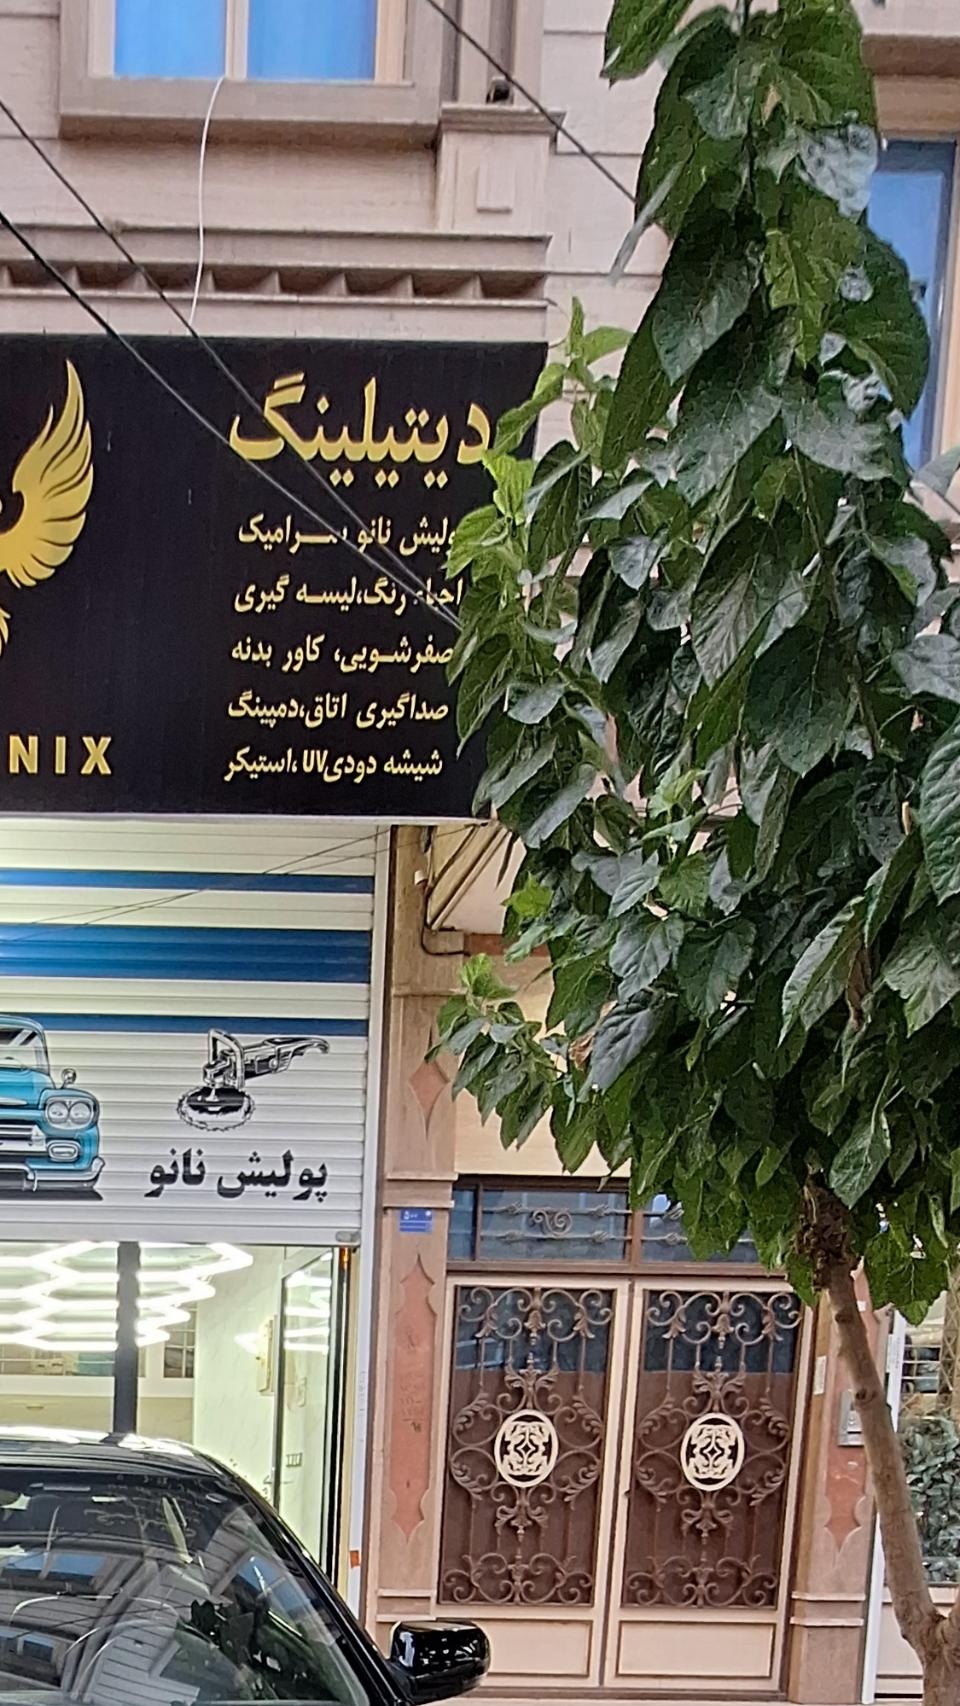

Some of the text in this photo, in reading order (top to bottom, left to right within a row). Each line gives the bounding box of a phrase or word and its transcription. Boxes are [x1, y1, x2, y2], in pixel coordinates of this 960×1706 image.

[228, 371, 491, 488] دیتیلینگ
[357, 515, 391, 554] نانو
[234, 574, 289, 612] گیری
[231, 636, 273, 668] بدنه
[281, 634, 325, 672] کاور
[356, 692, 449, 729] صداگیری
[383, 748, 444, 782] شیشه
[144, 1148, 329, 1203] پولیش نانو
